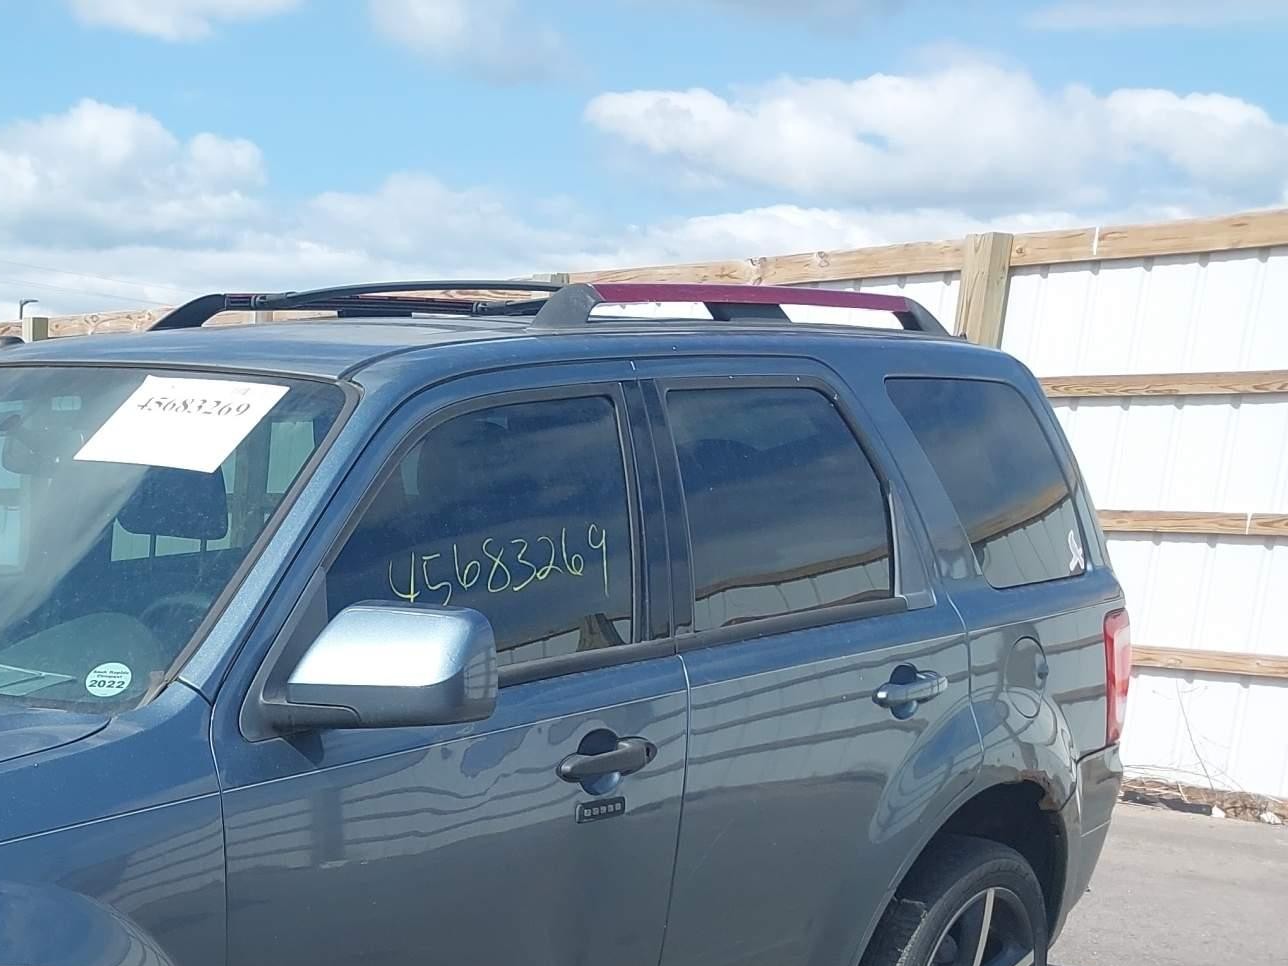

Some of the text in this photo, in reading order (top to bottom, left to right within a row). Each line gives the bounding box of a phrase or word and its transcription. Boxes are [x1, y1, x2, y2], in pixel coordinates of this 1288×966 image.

[137, 396, 251, 417] 45683269
[389, 521, 608, 606] 45683269
[88, 679, 125, 689] 2022
